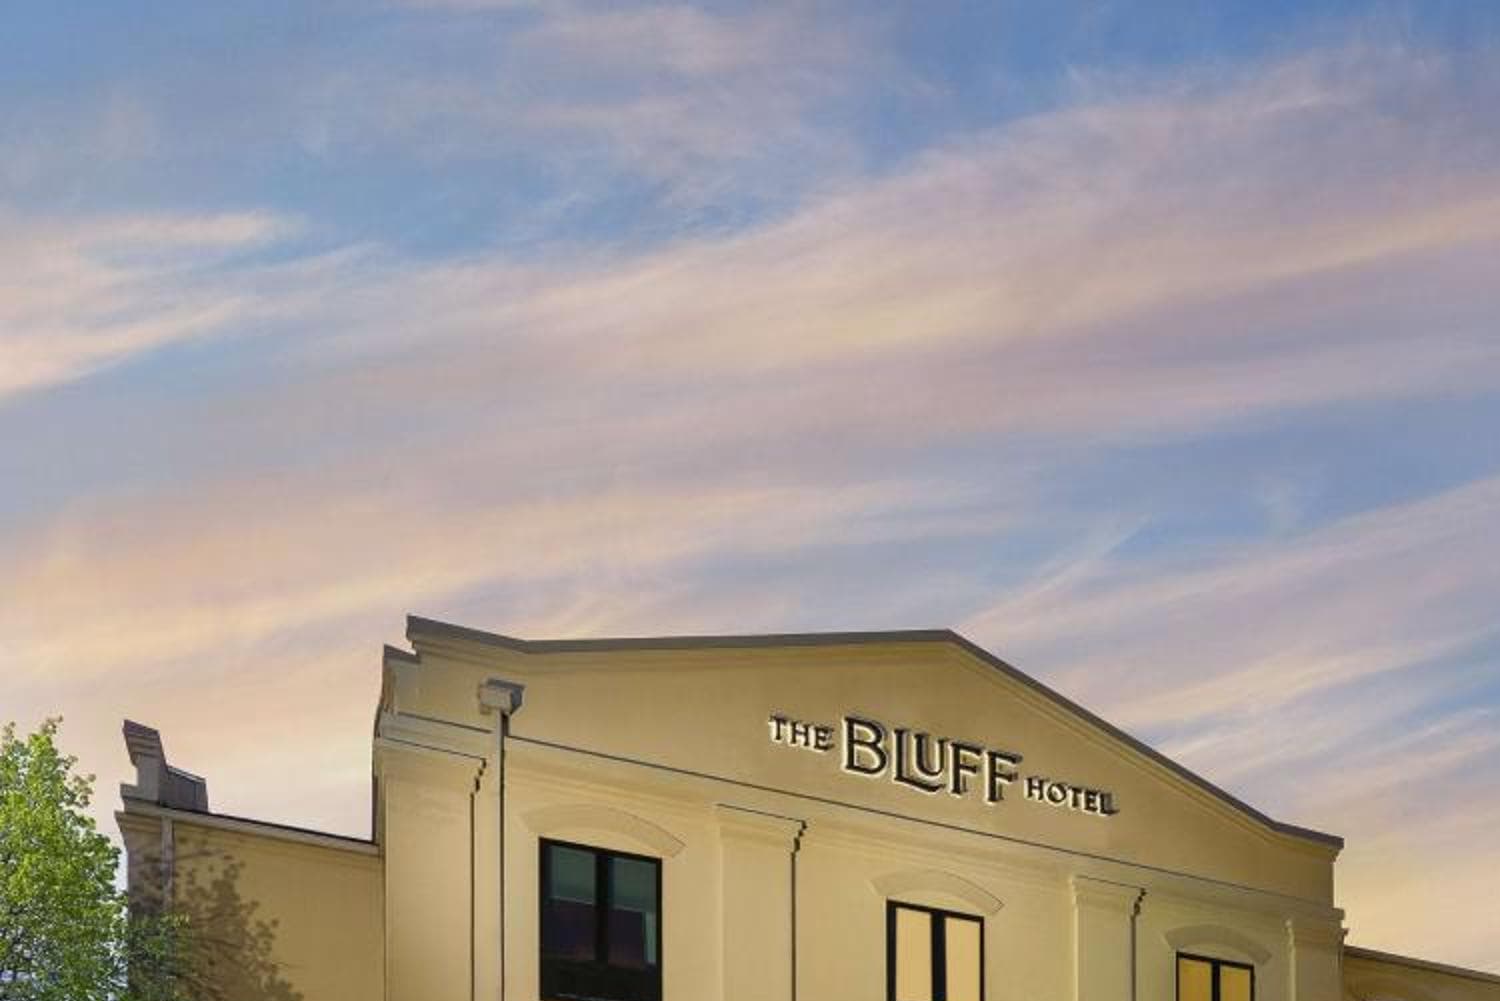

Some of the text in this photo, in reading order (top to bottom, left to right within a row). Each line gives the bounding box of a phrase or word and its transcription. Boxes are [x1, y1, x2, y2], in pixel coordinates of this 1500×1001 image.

[768, 713, 1121, 817] THE BLUFF HOTEL
